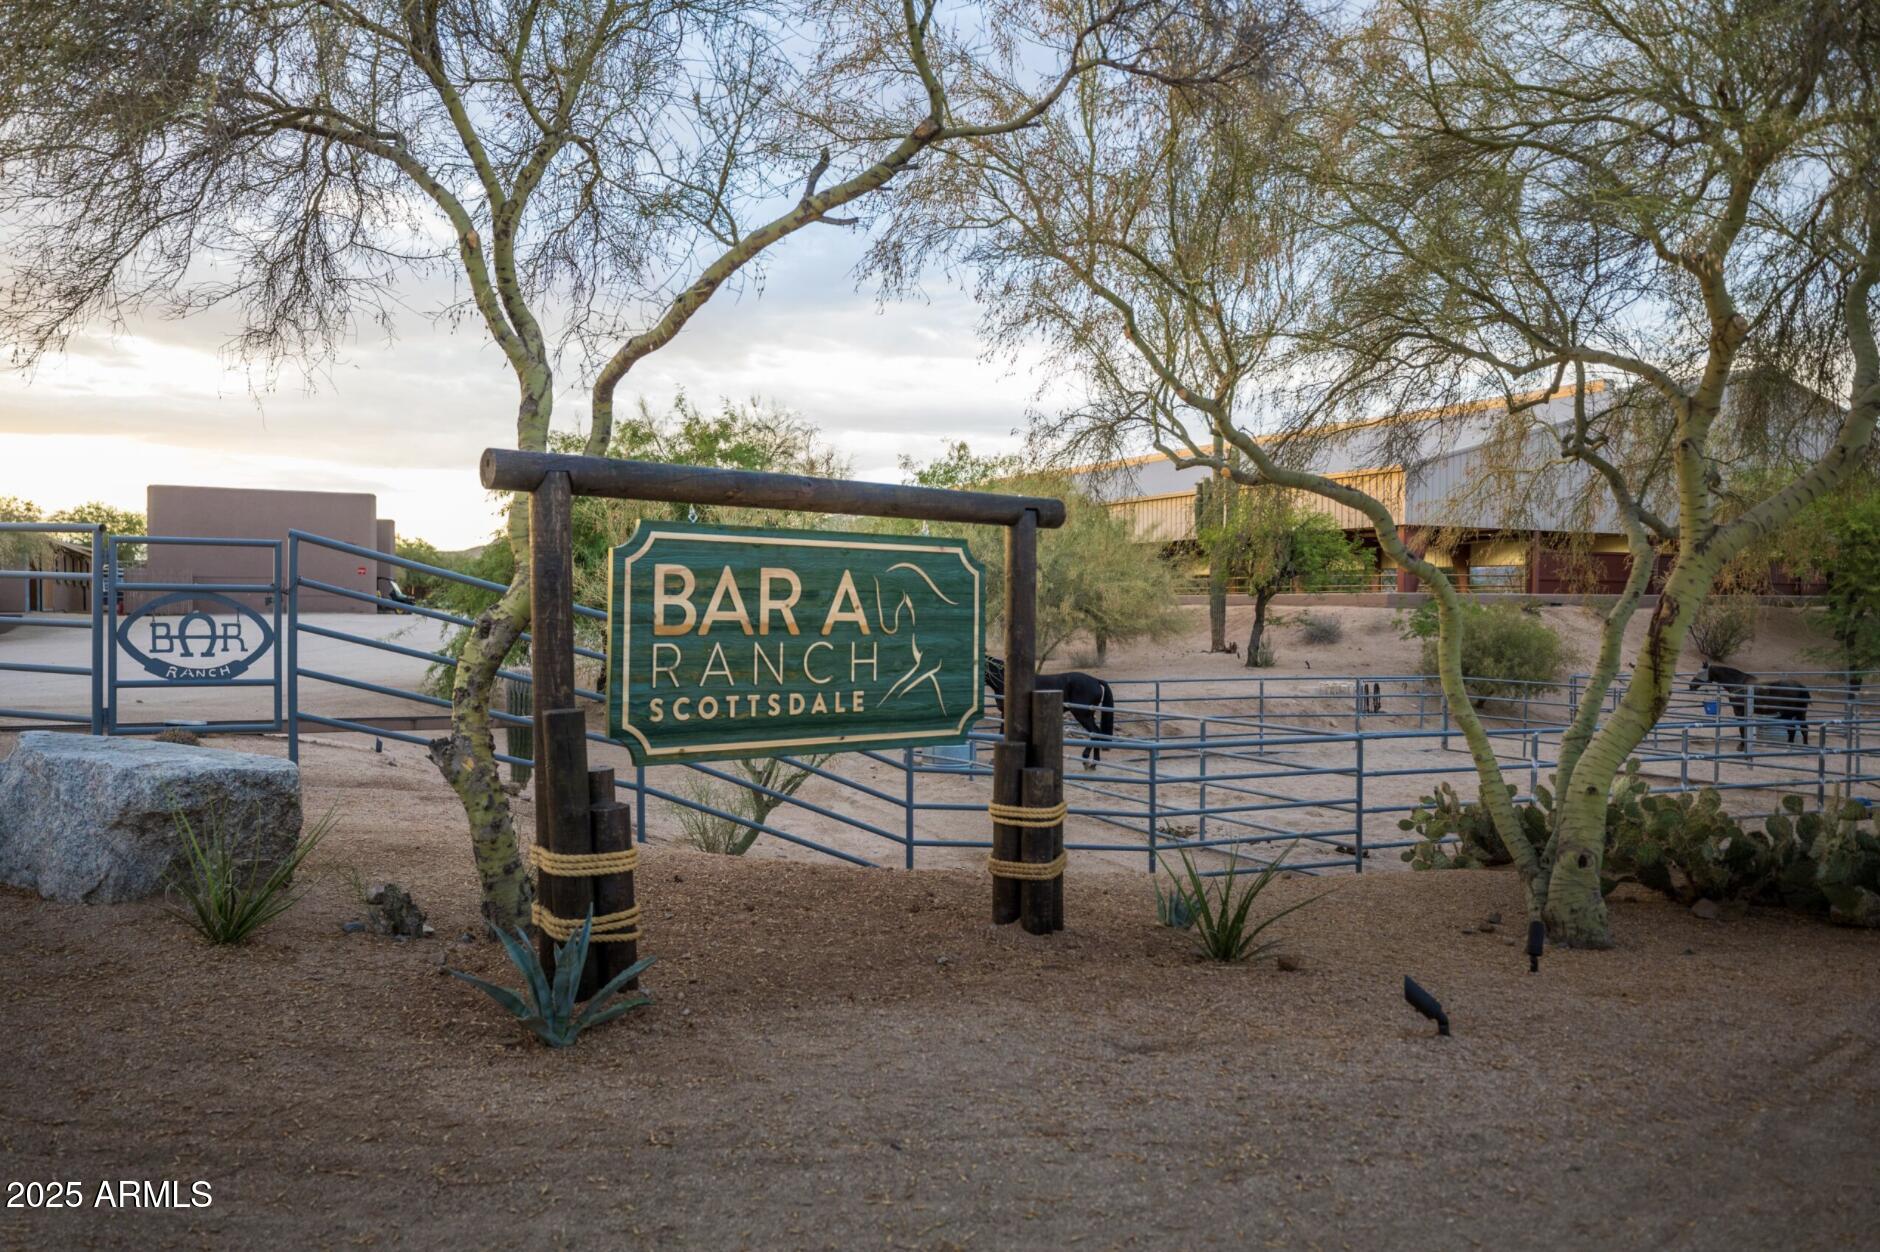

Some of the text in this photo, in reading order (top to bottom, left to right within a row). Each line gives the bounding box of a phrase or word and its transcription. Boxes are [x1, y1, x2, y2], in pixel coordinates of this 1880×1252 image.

[653, 563, 871, 636] BAR A
[165, 665, 231, 679] RANCH
[651, 640, 878, 690] RANCH
[649, 690, 865, 723] SCOTTSDALE
